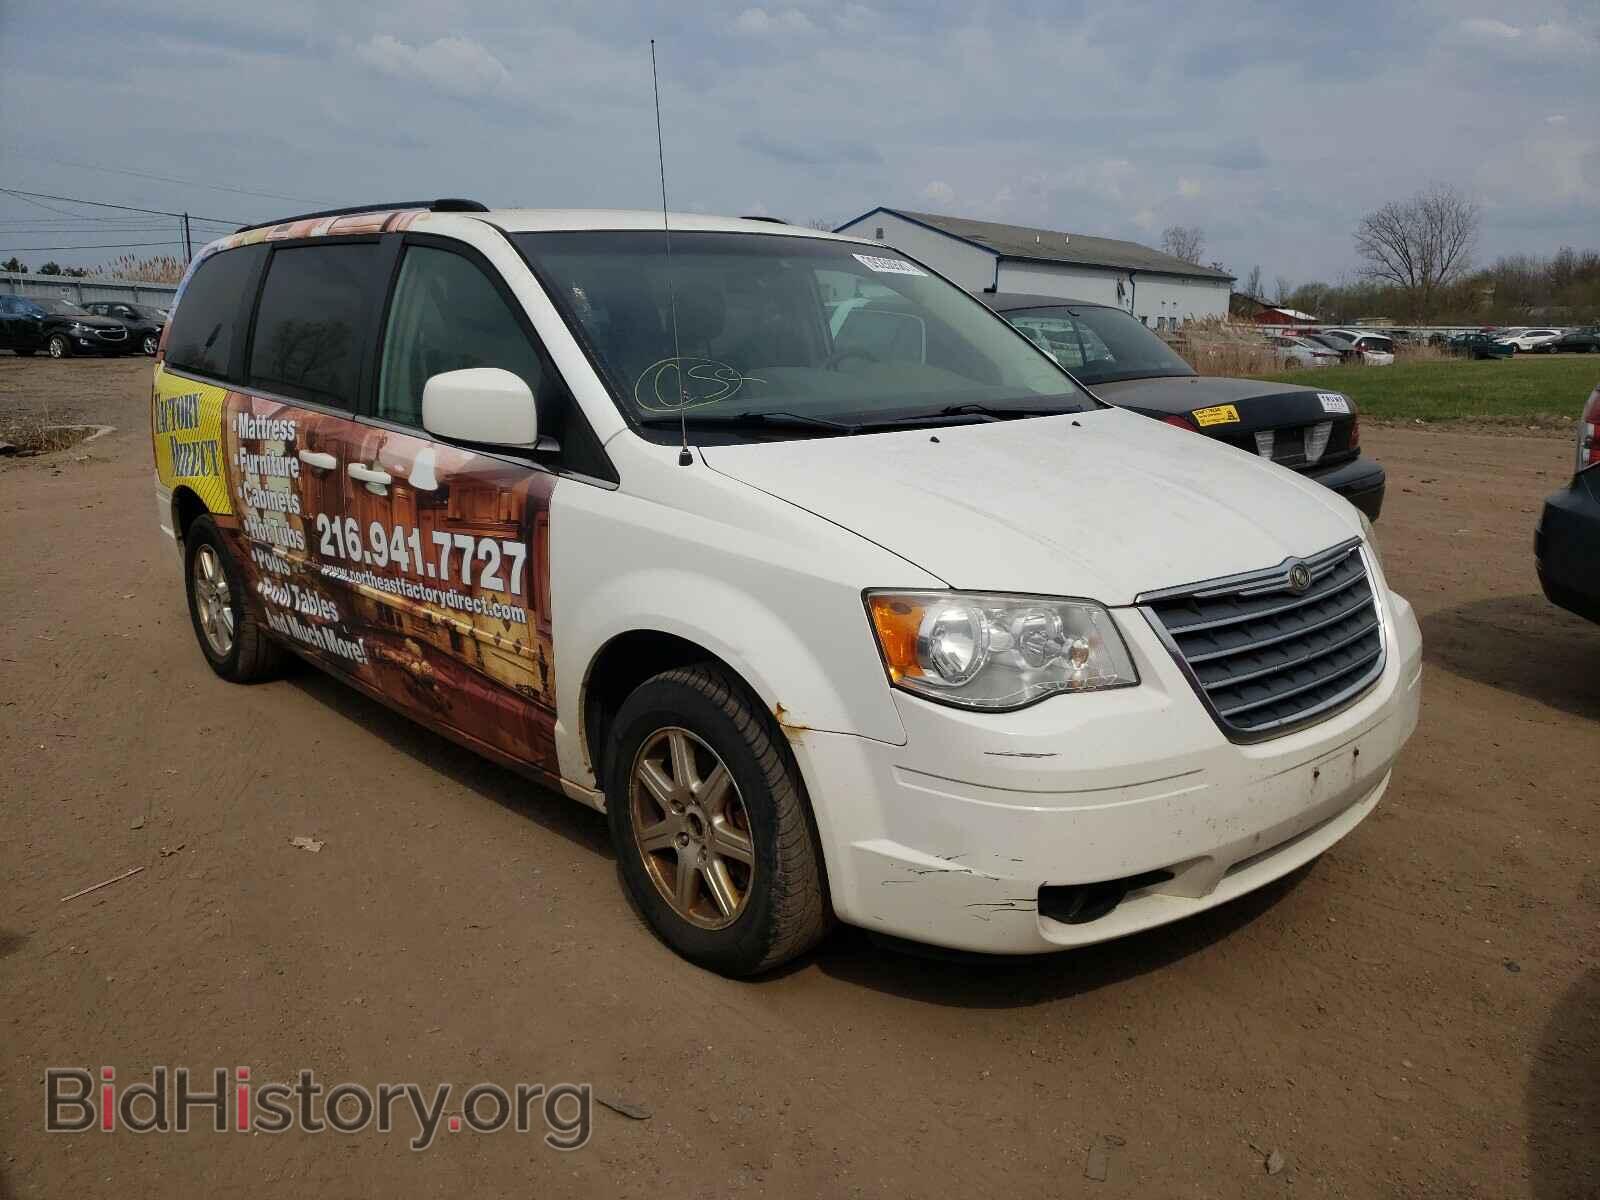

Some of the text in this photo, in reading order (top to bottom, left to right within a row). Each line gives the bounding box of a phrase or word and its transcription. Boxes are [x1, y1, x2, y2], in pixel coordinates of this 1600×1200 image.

[238, 412, 296, 441] Mattress
[240, 447, 300, 478] Furniture
[244, 480, 300, 514] Cabinets
[316, 512, 527, 595] 216.941.7727
[262, 577, 340, 622] Pool Tables
[321, 563, 528, 624] www.northeastfactorydirect.com
[287, 615, 325, 649] Much
[321, 626, 369, 666] More!
